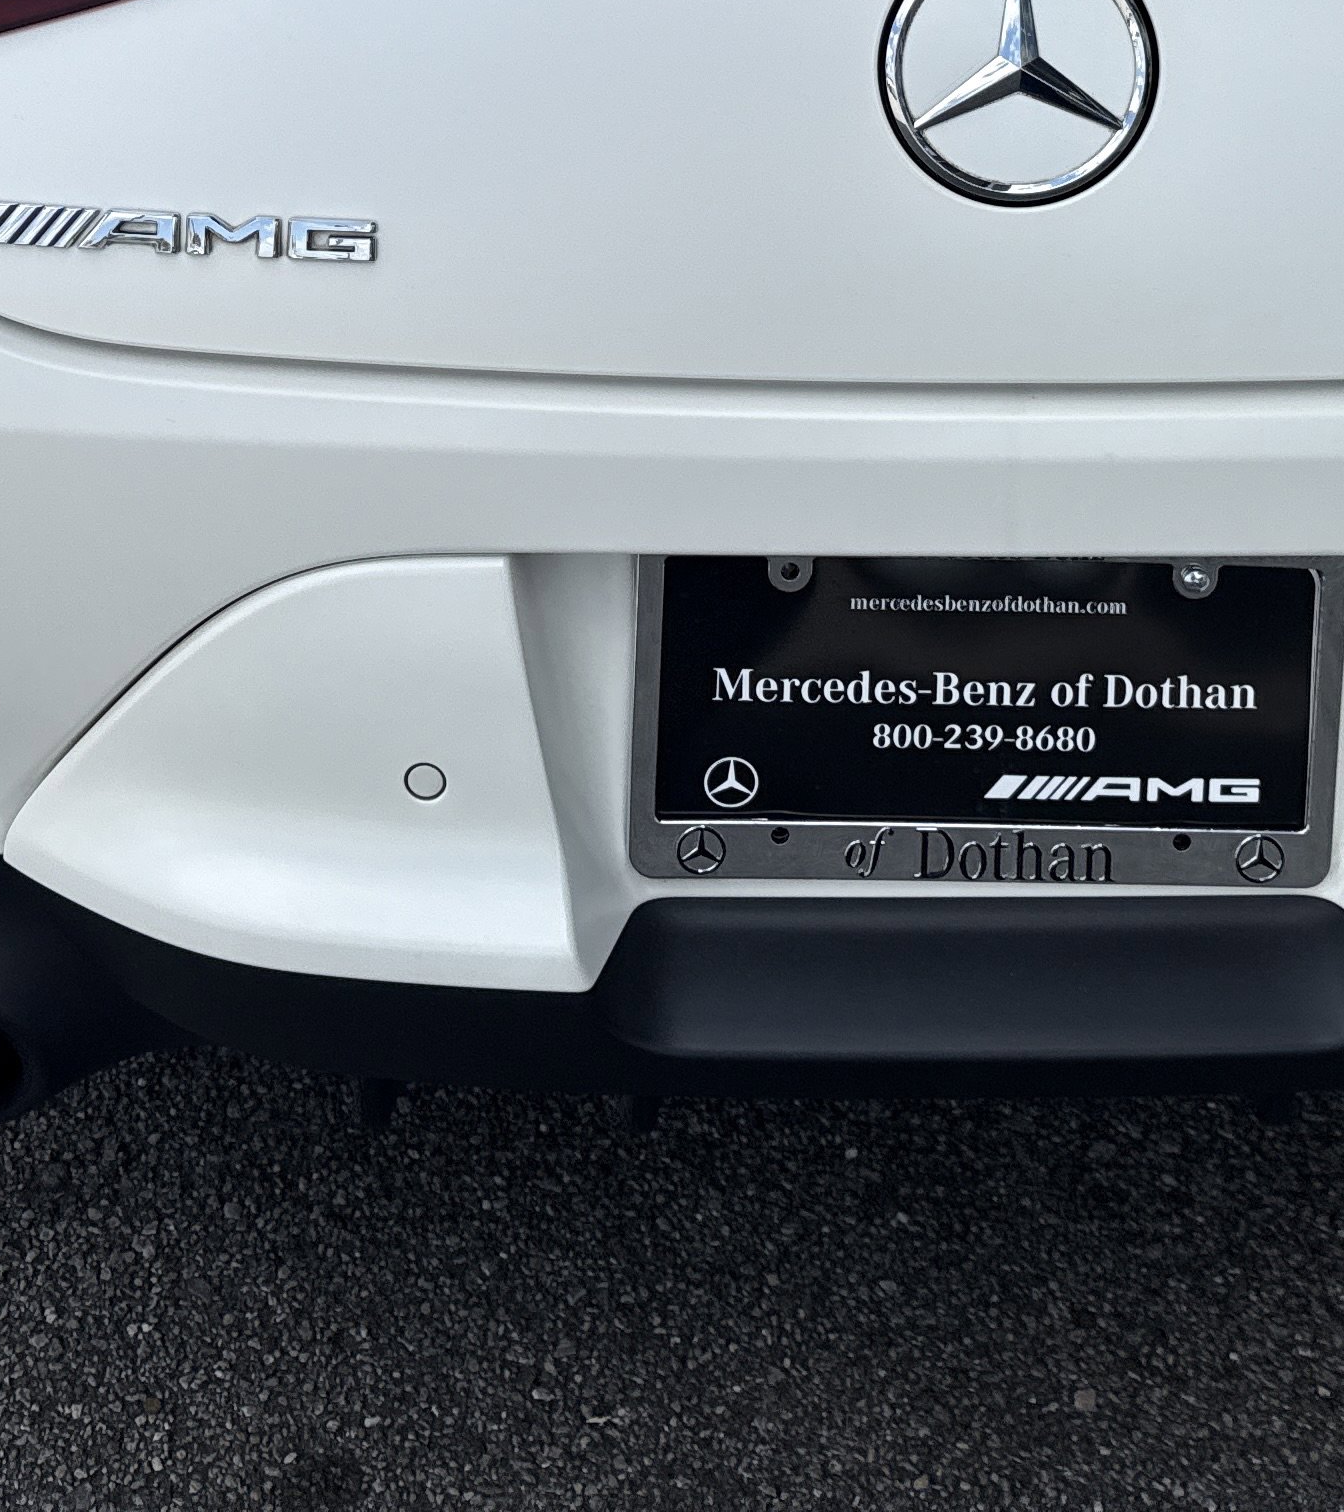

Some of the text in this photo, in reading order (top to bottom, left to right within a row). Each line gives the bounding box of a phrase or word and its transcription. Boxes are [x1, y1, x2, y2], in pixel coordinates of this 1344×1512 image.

[78, 208, 378, 263] AMG
[849, 595, 1128, 615] mercedesbenzofdothan.com
[712, 667, 1258, 710] Mercedes-Benz of Dothan
[872, 723, 1097, 753] 800-239-8680
[1080, 775, 1262, 804] AMG
[844, 826, 1116, 882] of Dothan
